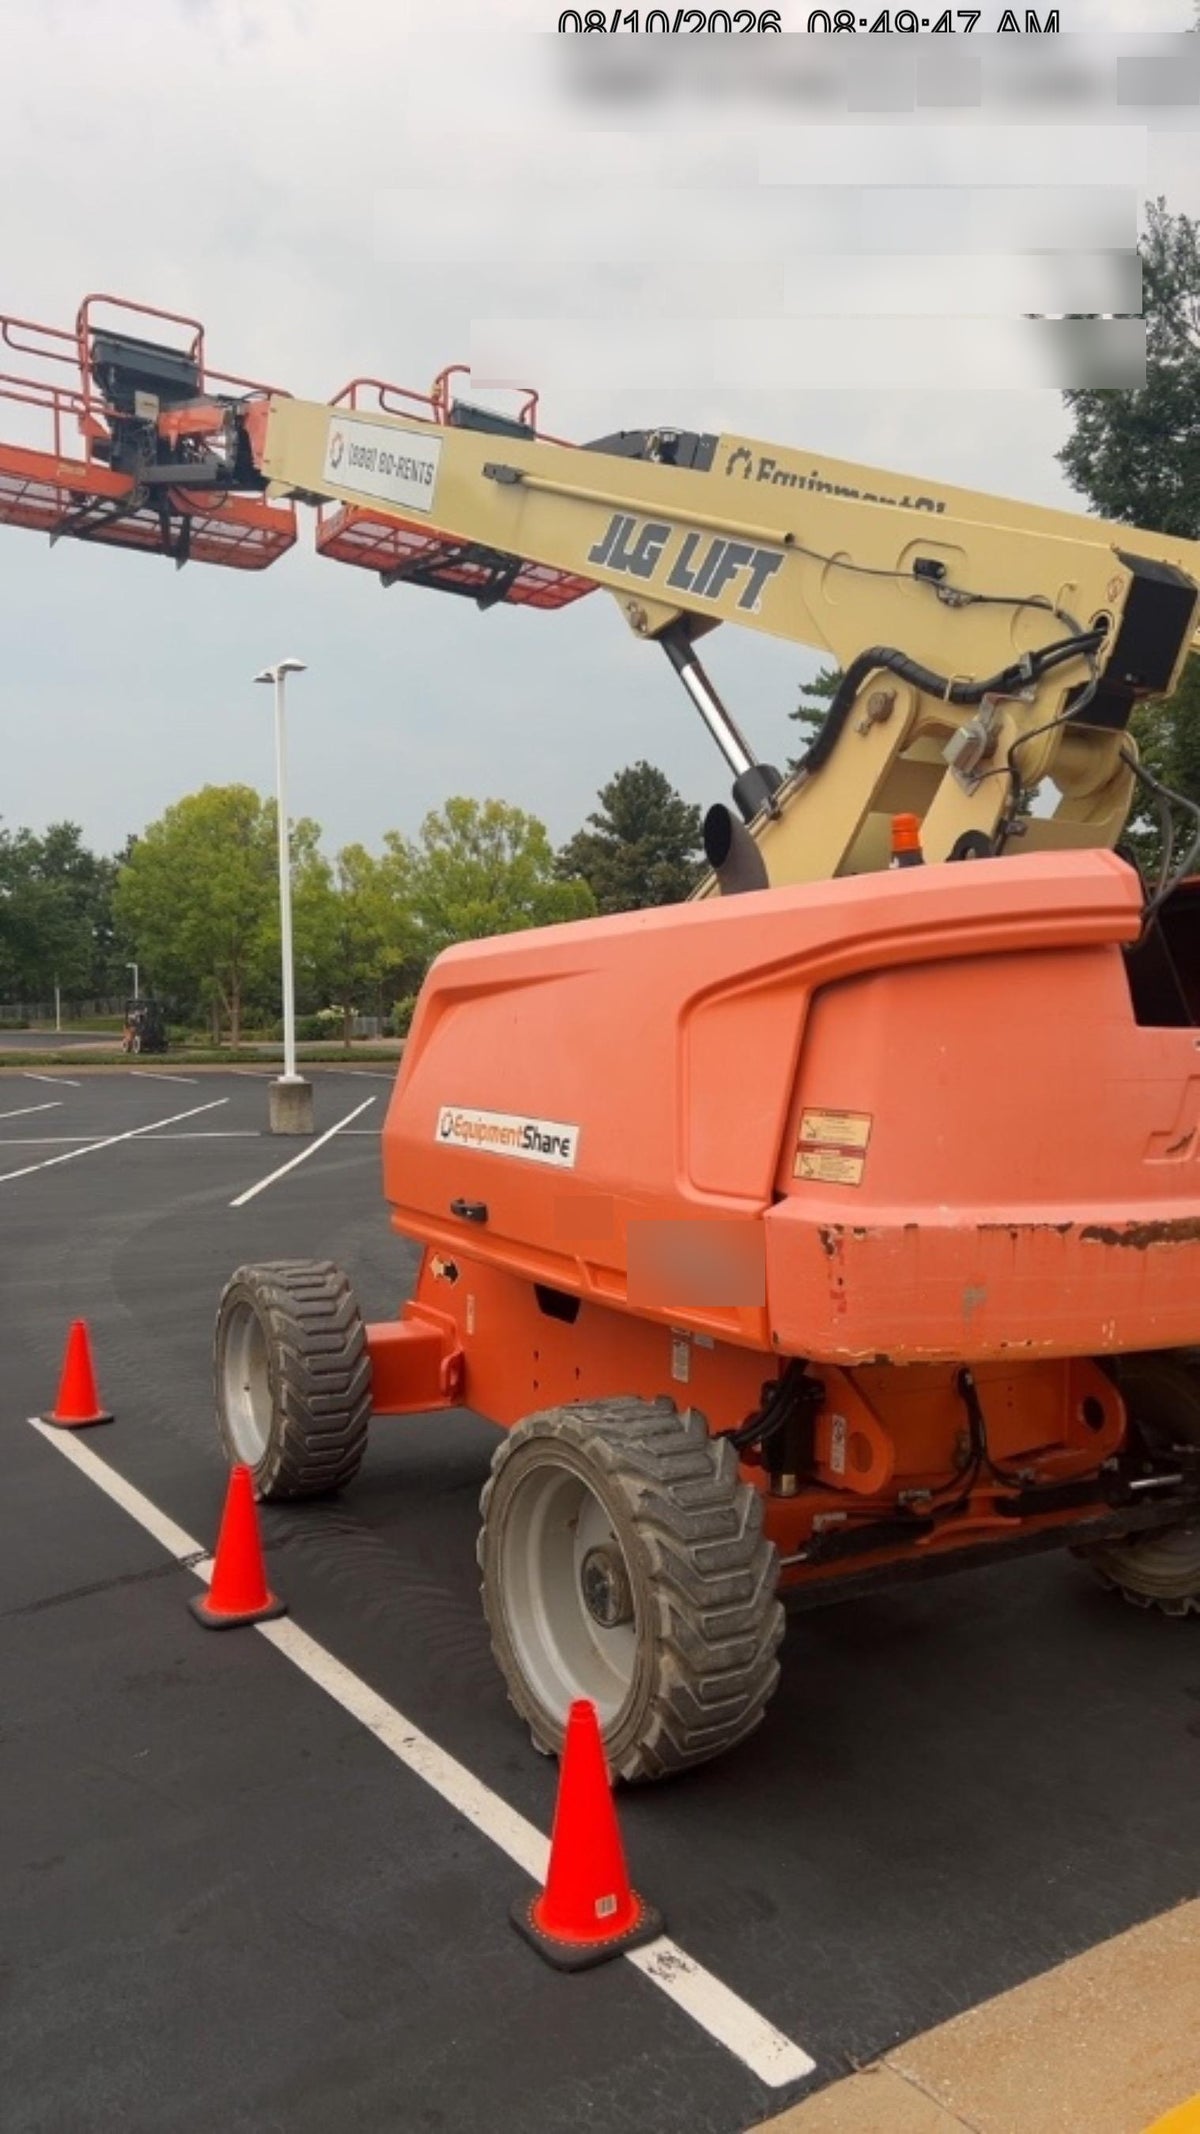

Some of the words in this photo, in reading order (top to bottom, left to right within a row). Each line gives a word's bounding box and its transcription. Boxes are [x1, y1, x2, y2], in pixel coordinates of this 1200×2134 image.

[587, 513, 672, 581] JLG
[665, 531, 787, 614] LIFT
[453, 1114, 571, 1158] EquipmentShare
